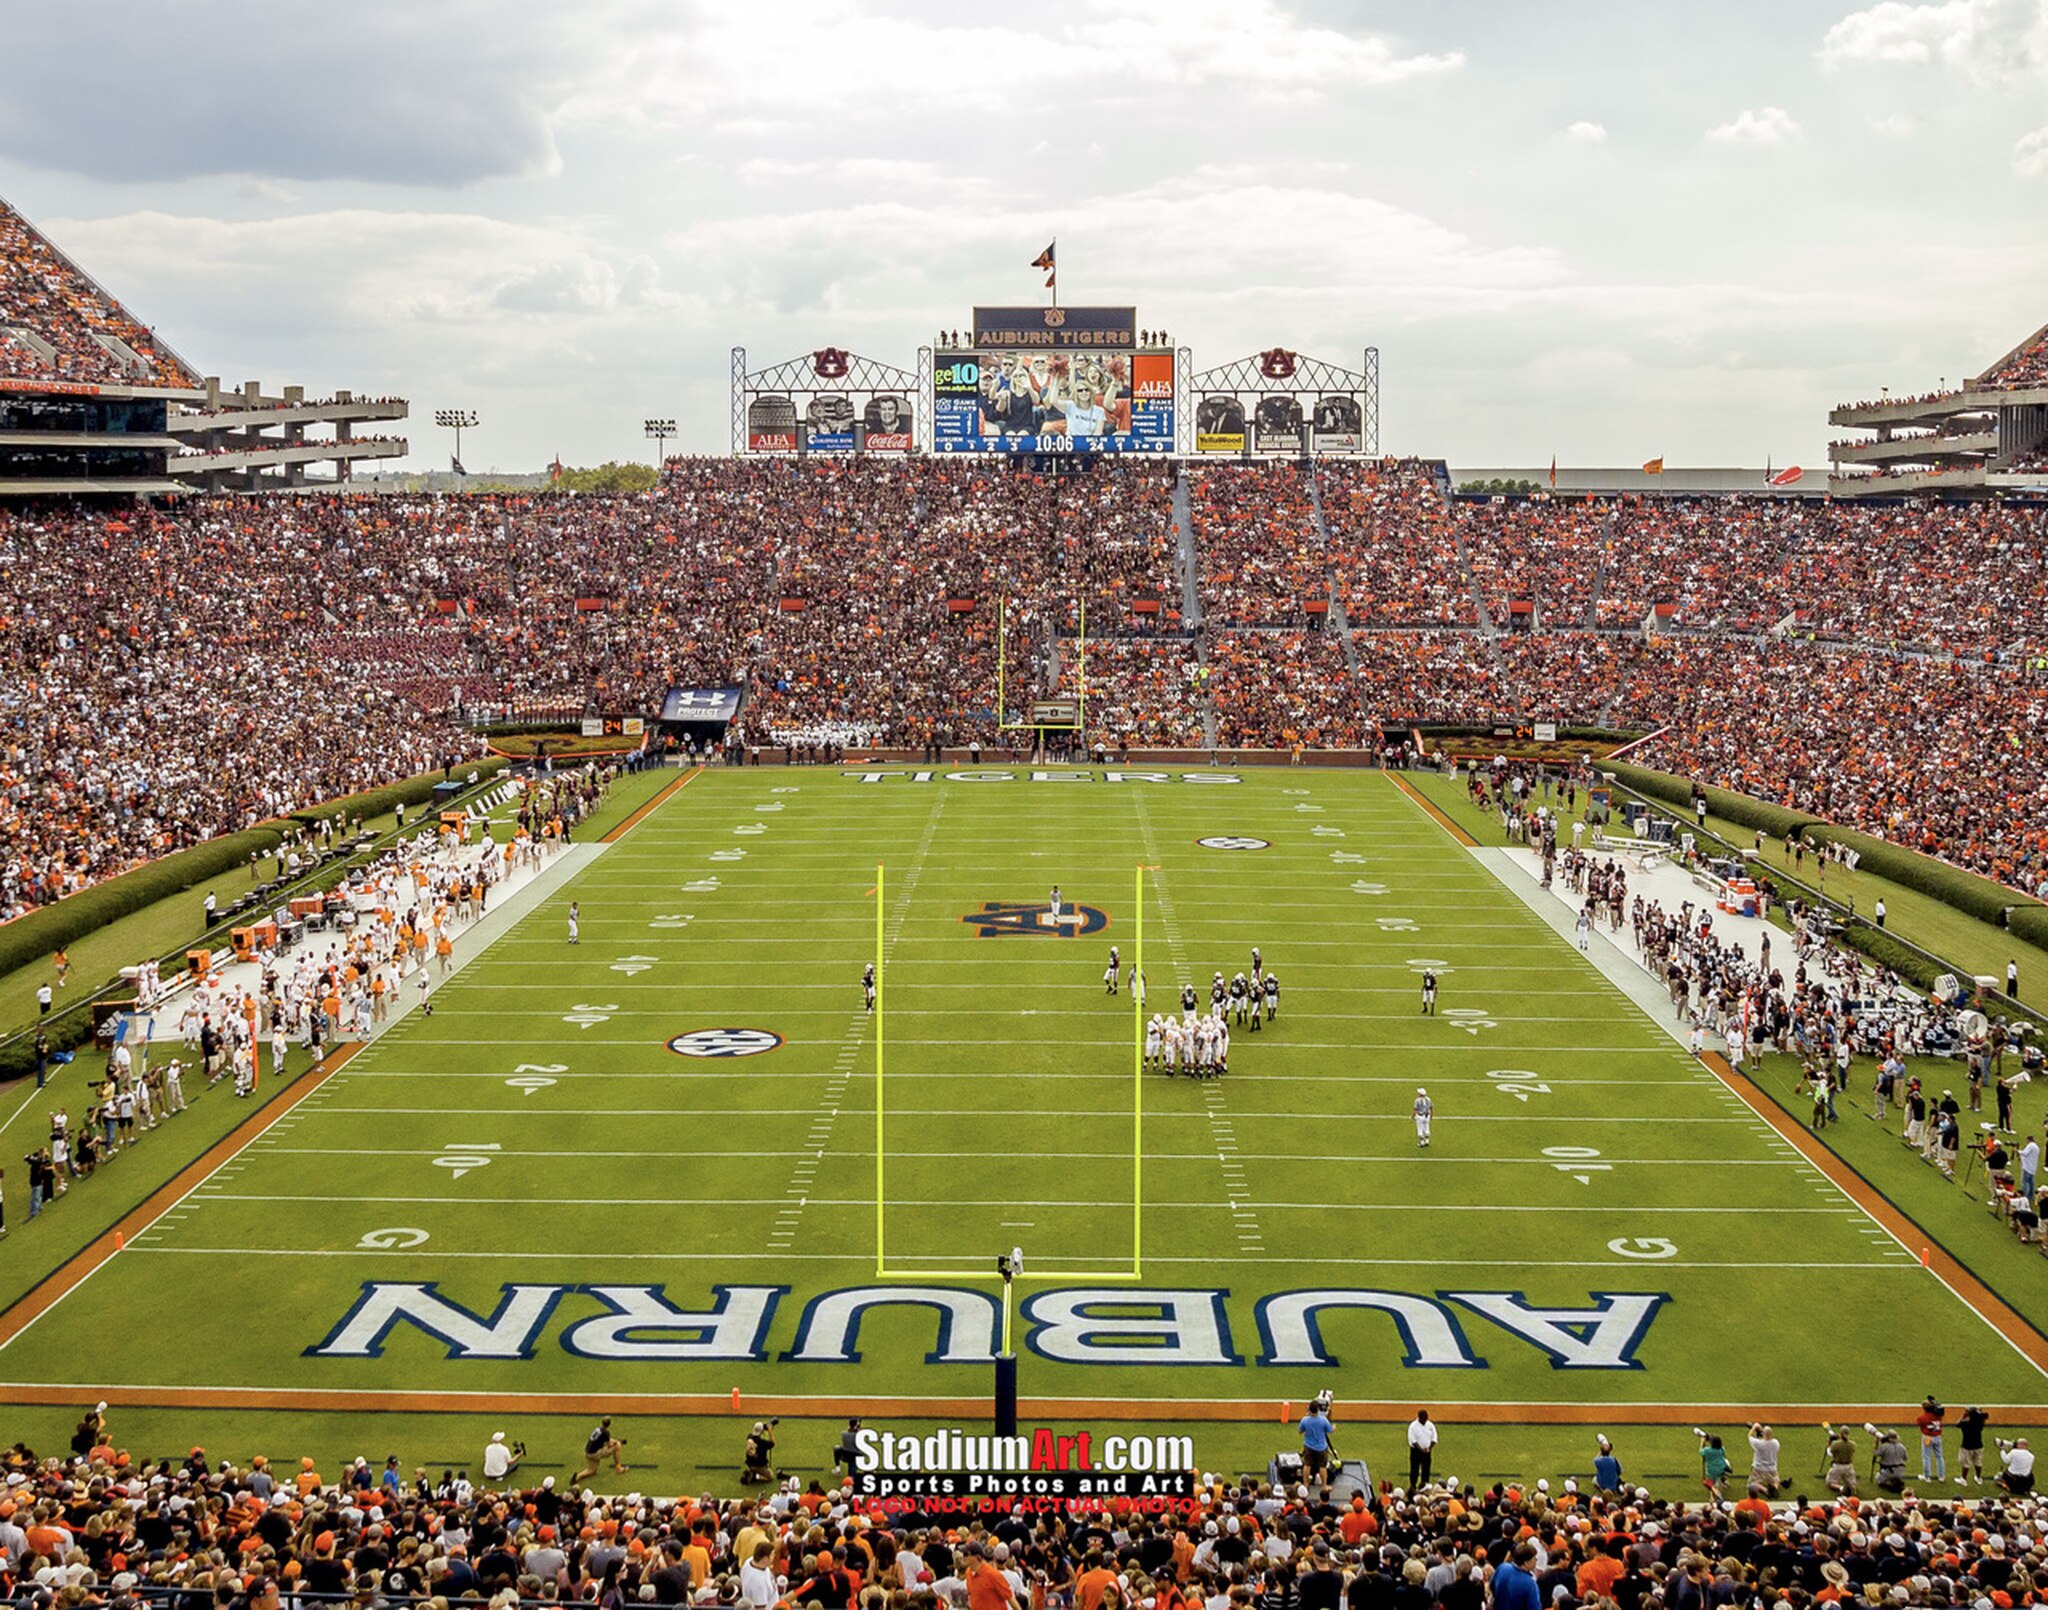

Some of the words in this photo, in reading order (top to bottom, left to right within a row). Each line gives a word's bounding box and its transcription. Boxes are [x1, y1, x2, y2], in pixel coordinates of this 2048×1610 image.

[979, 331, 1054, 344] AUBURN
[1060, 331, 1130, 344] TIGERS
[1138, 381, 1173, 394] ALFA
[756, 434, 790, 446] ALFA
[1035, 435, 1074, 452] 10:06
[987, 442, 995, 452] 2
[1010, 442, 1018, 452] 3
[1089, 442, 1105, 452] 24
[1116, 442, 1123, 452] 1
[1155, 442, 1164, 452] 0
[604, 720, 622, 734] 24
[1516, 725, 1533, 738] 24
[841, 771, 1243, 784] TIGERS
[505, 1064, 569, 1087] 20
[1486, 1070, 1552, 1094] 20
[432, 1143, 501, 1167] 10
[1541, 1146, 1613, 1171] 10
[355, 1228, 430, 1247] G
[1607, 1238, 1678, 1259] G
[304, 1281, 1674, 1371] AUBURN
